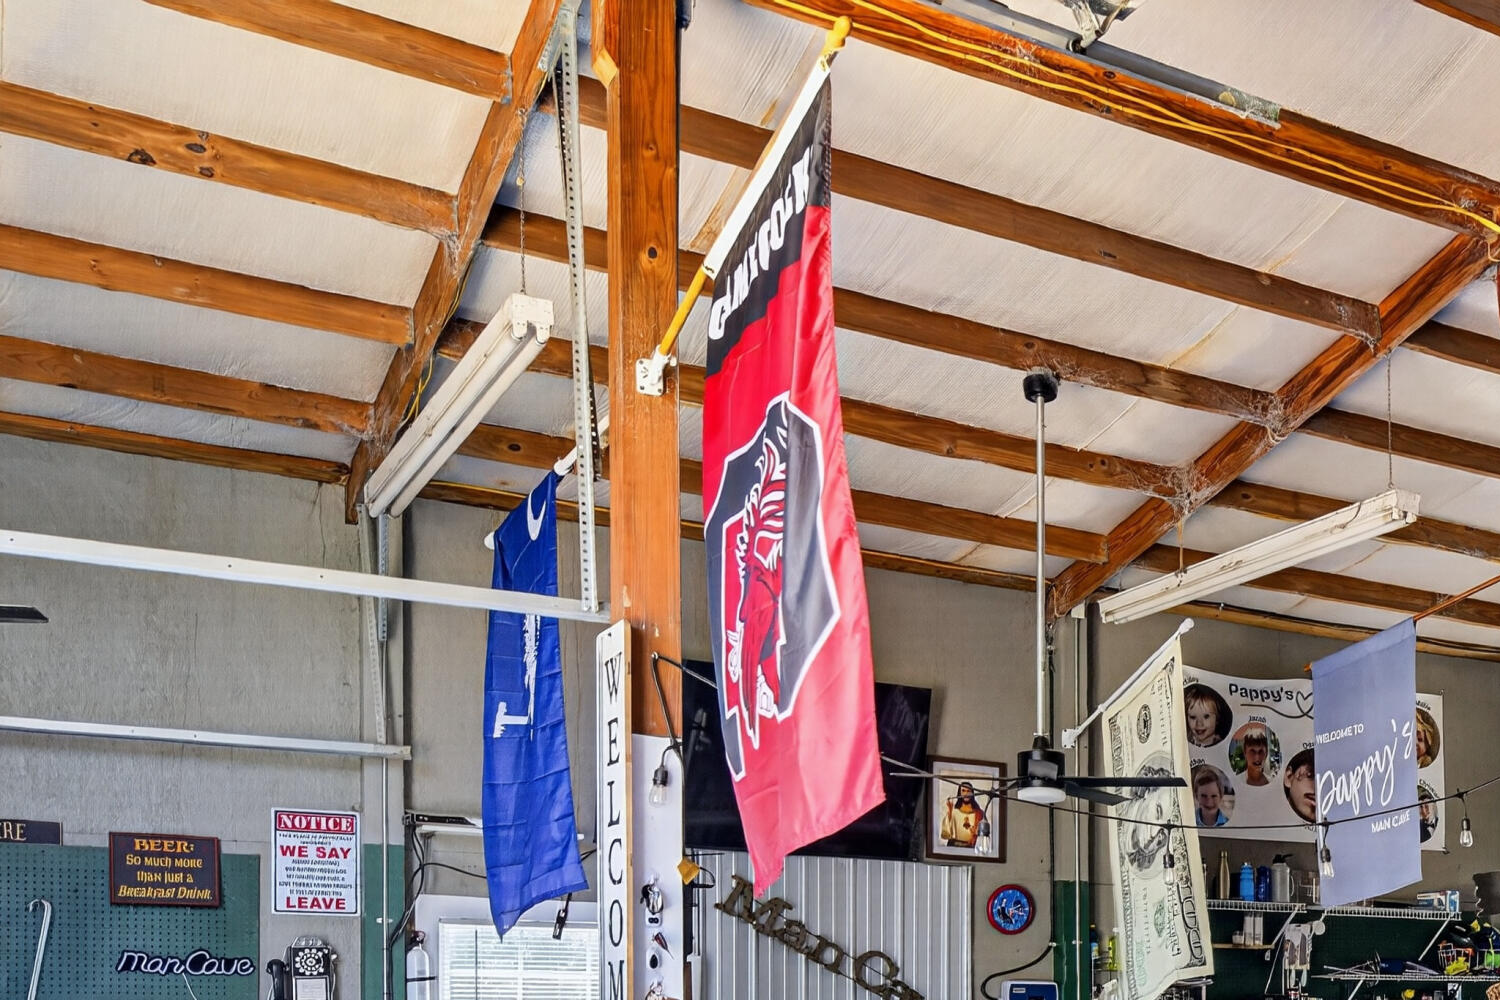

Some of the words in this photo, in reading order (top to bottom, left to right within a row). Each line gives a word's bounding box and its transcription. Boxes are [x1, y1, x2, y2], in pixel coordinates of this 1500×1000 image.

[1228, 683, 1295, 703] Pappy's
[1316, 726, 1353, 745] WELCOME
[1353, 723, 1364, 736] TO
[1316, 718, 1414, 848] Pappy's
[0, 821, 26, 841] RE
[280, 814, 352, 832] NOTICE
[1371, 816, 1391, 833] MAN
[1392, 809, 1410, 828] CAVE
[134, 838, 195, 853] BEER:
[280, 845, 308, 858] WE
[316, 846, 351, 859] SAY
[286, 896, 346, 910] LEAVE
